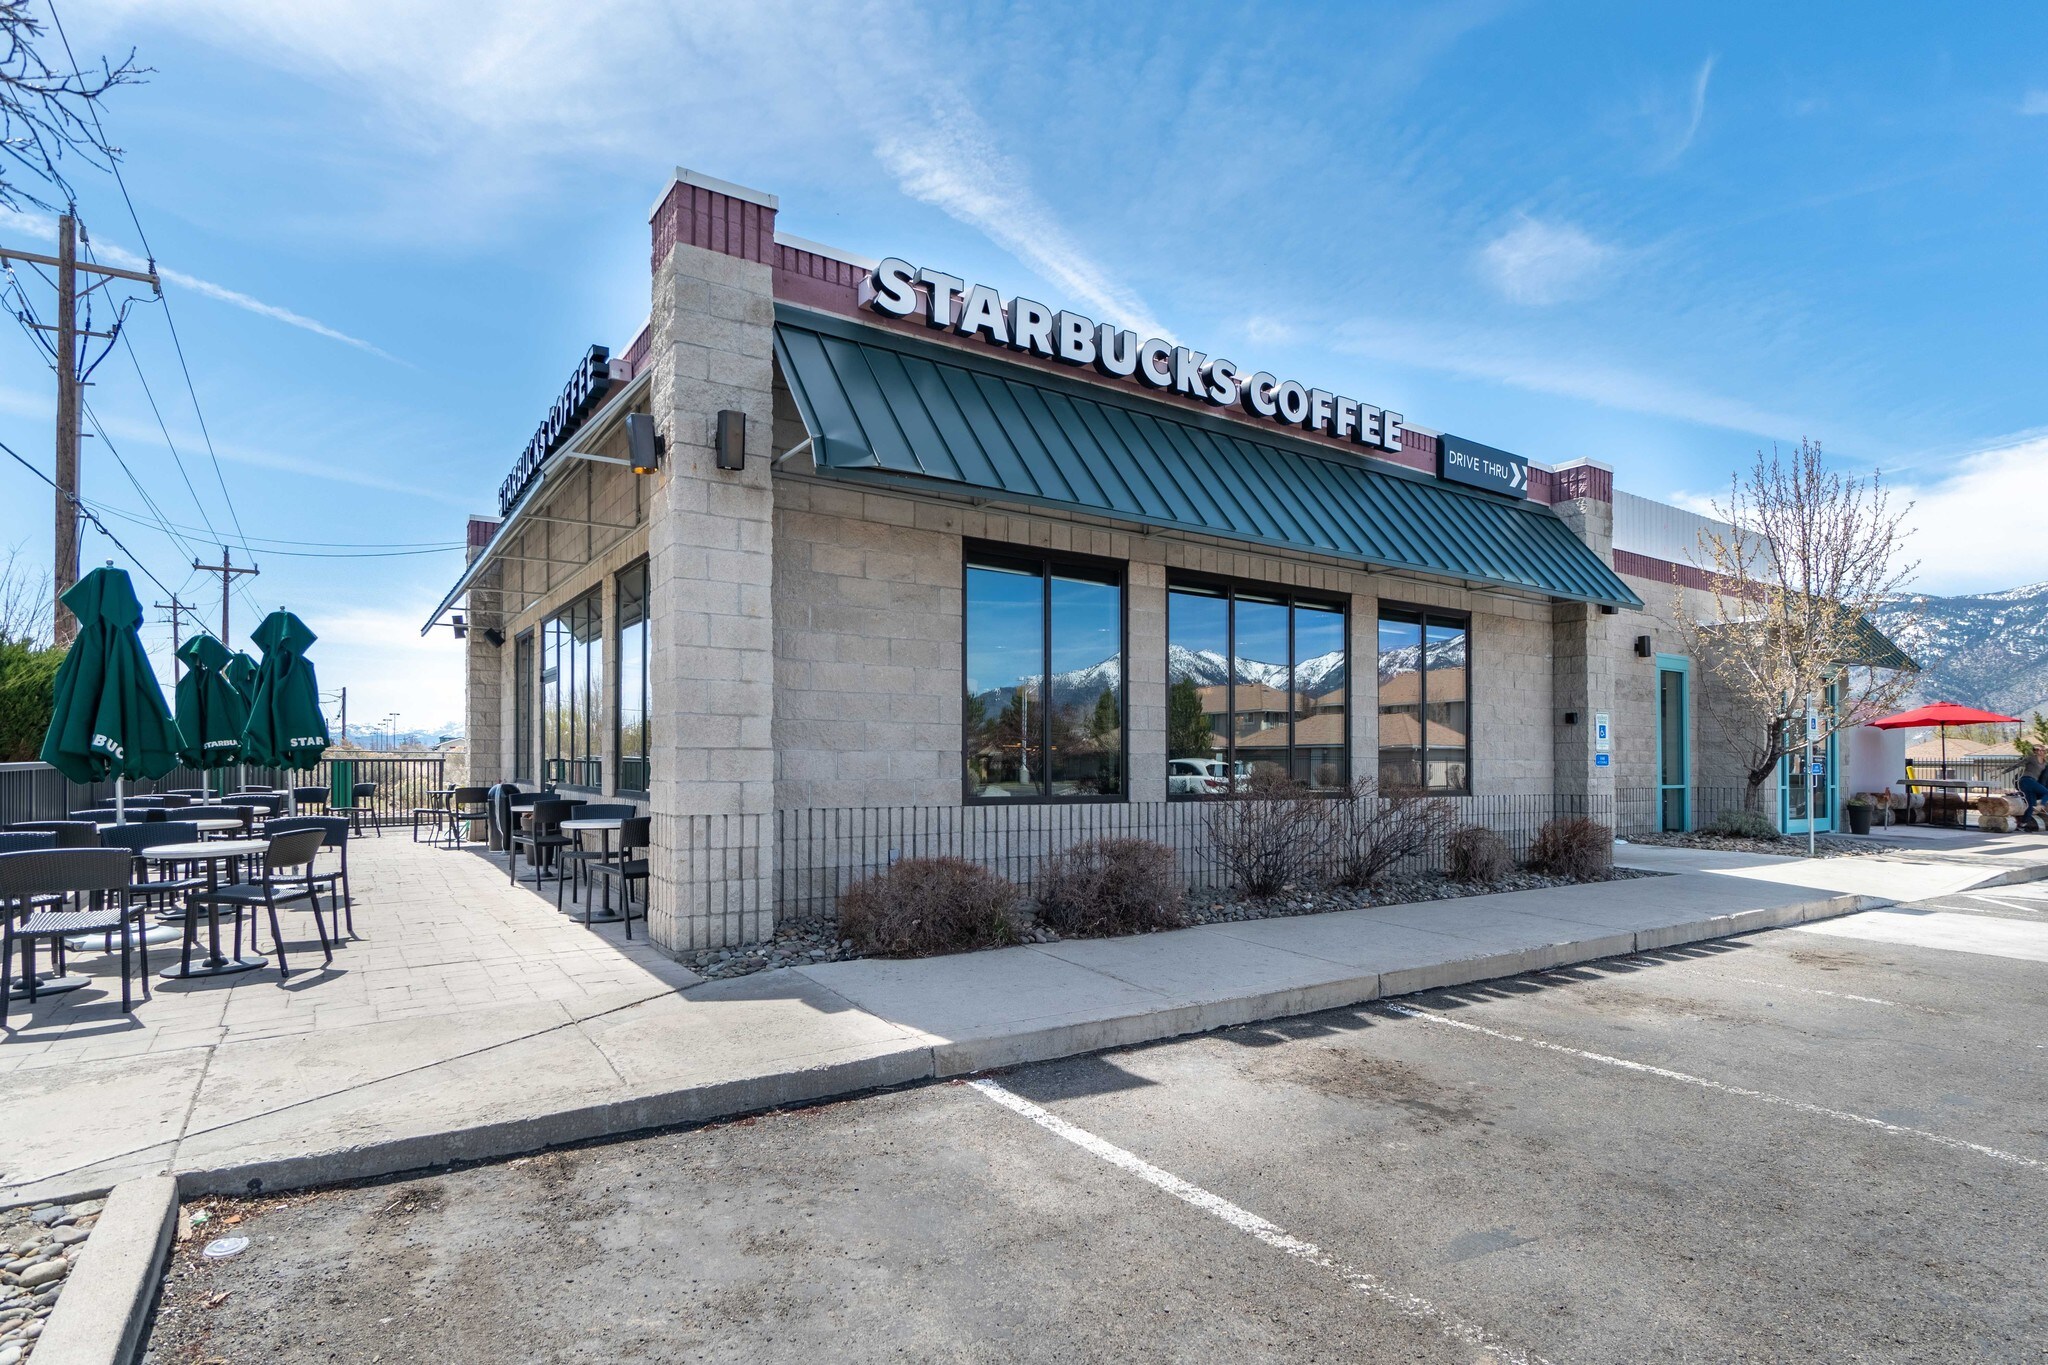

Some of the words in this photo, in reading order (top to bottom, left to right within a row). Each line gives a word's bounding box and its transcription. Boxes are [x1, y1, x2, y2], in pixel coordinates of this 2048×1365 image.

[871, 256, 1238, 408] STARBUCKS
[1240, 370, 1404, 453] COFFEE
[498, 420, 548, 518] STARBUCKS
[547, 344, 609, 447] COFFEE
[1449, 450, 1480, 472] DRIVE
[1482, 460, 1509, 479] THRU
[290, 736, 325, 747] STAR
